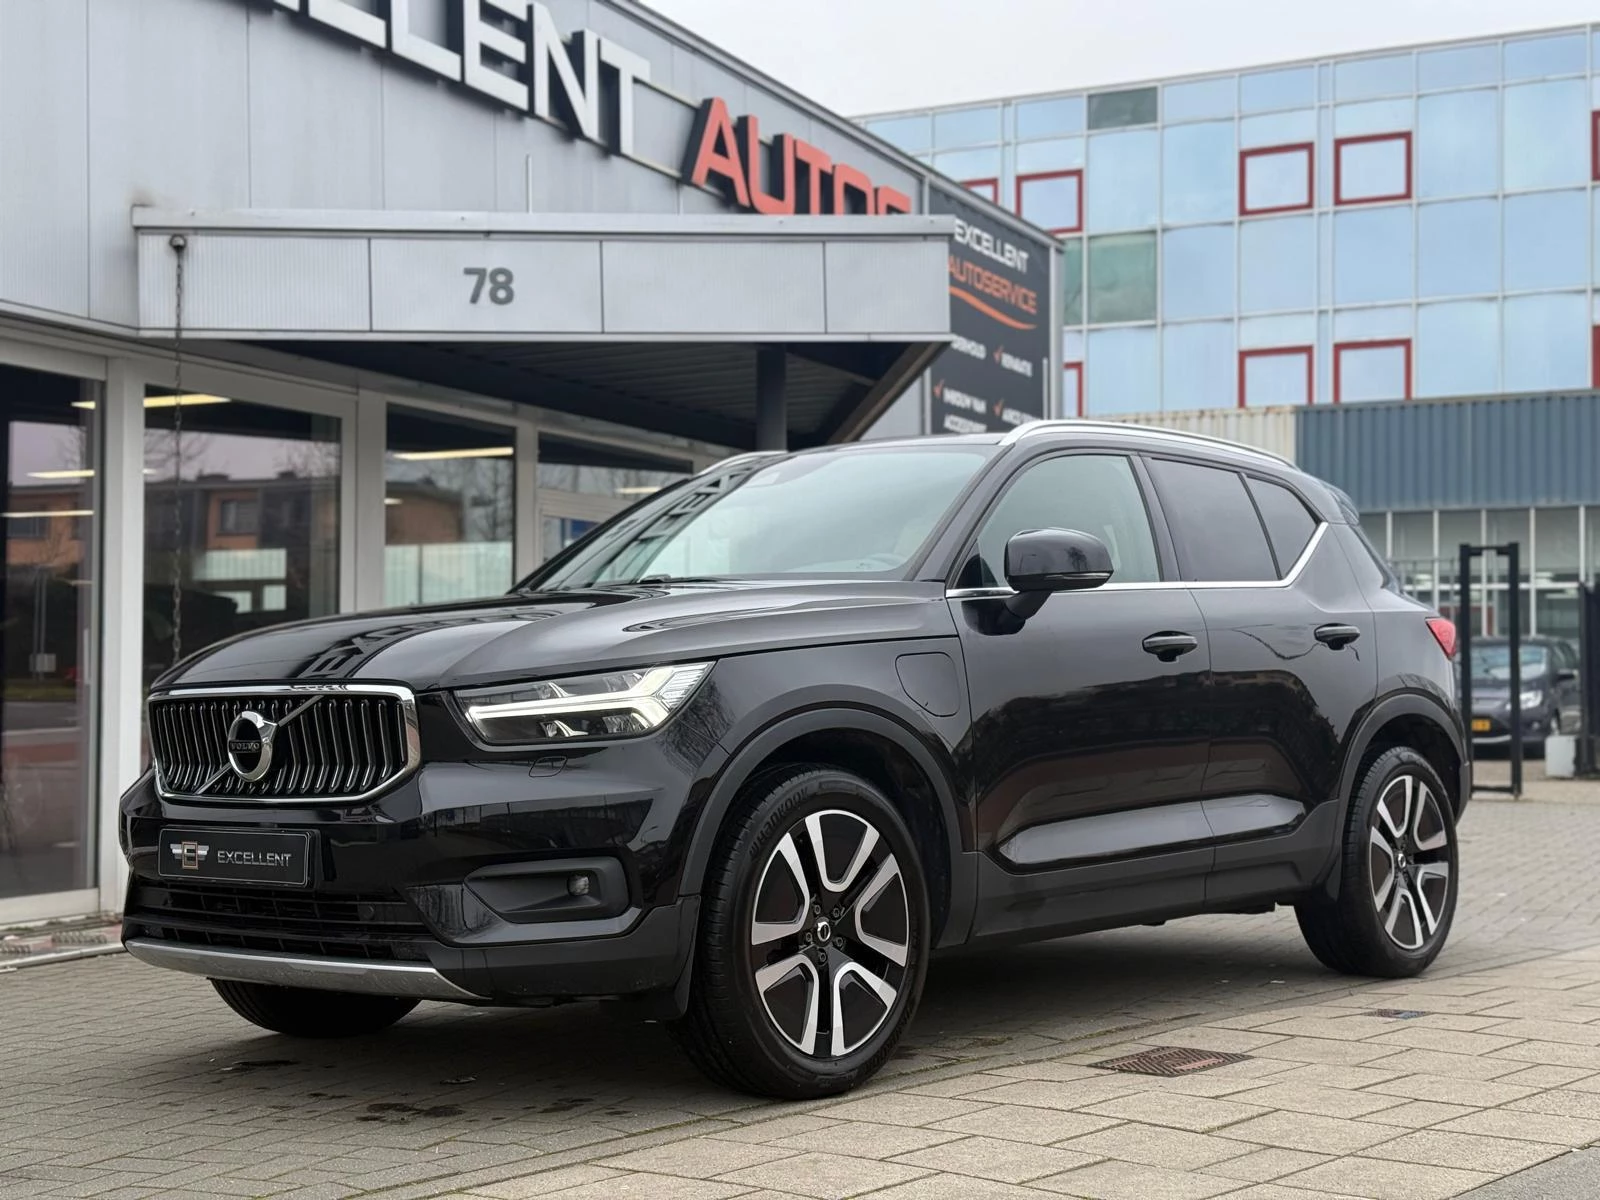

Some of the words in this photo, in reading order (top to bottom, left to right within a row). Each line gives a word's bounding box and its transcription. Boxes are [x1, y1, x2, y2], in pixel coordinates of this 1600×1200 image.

[274, 0, 650, 157] LENT
[954, 218, 1029, 274] EXCELLENT
[463, 267, 514, 305] 78
[949, 255, 1037, 315] AUTOSERVICE
[230, 742, 260, 750] VOLVO
[217, 850, 292, 867] EXCELLENT
